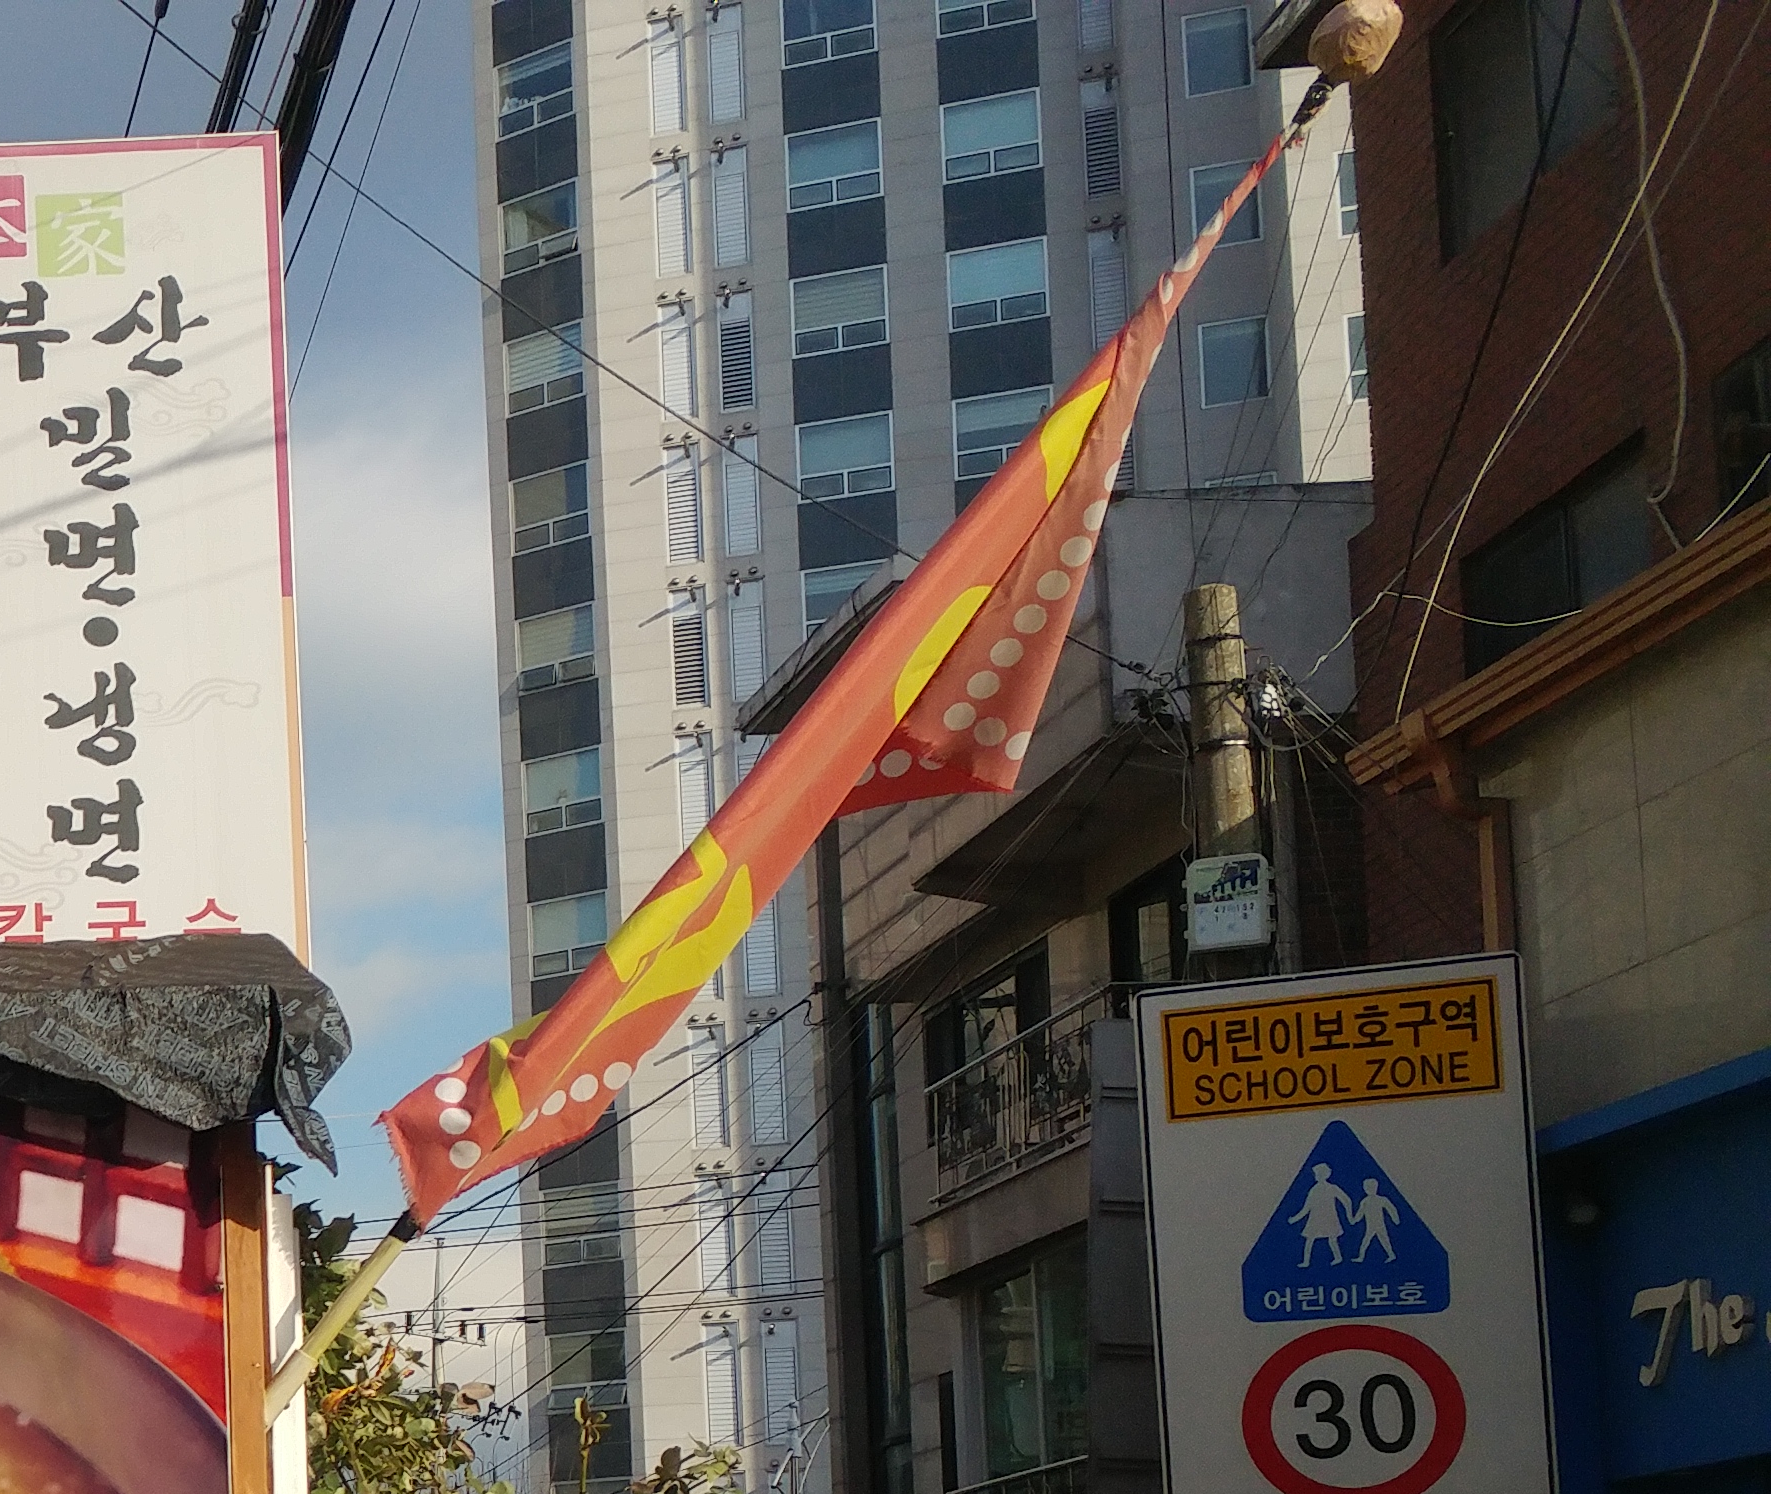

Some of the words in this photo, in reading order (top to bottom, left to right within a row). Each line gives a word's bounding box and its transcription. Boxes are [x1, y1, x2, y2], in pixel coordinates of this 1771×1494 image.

[1181, 994, 1479, 1068] 어린이보호구역
[1194, 1062, 1351, 1106] SCHOOL
[1366, 1051, 1472, 1089] ZONE
[1263, 1281, 1428, 1313] 어린이보호
[1629, 1278, 1751, 1388] The
[1291, 1371, 1417, 1460] 30
